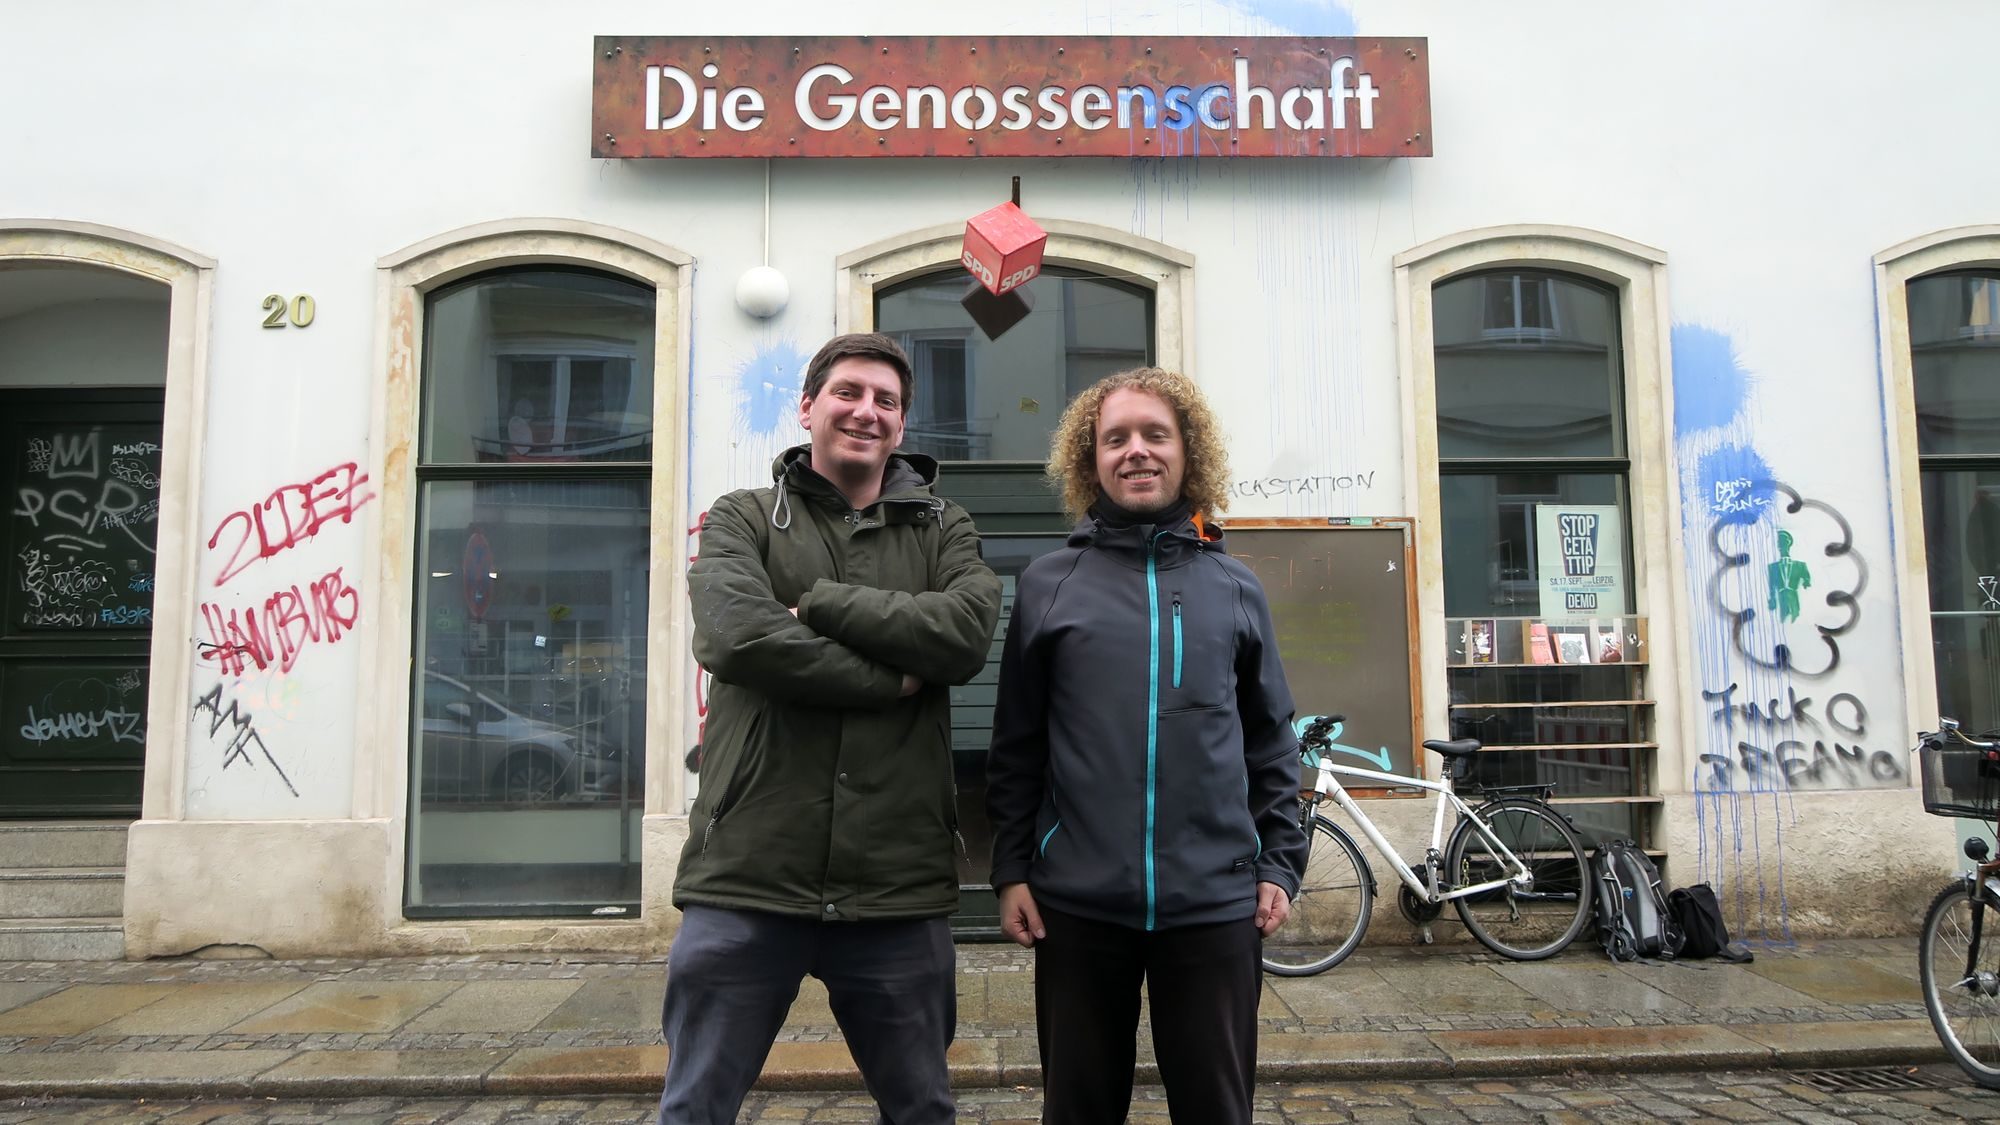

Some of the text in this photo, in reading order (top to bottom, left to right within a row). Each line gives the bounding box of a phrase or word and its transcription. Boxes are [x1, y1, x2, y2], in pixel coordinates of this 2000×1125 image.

[645, 55, 1380, 132] Die Genossenschaft
[961, 250, 994, 286] SPD
[1000, 264, 1037, 291] SPD
[262, 293, 316, 328] 20
[1561, 515, 1596, 537] STOP
[1563, 536, 1594, 556] CETA
[1566, 555, 1594, 574] TTIP
[1567, 593, 1596, 609] DEMO
